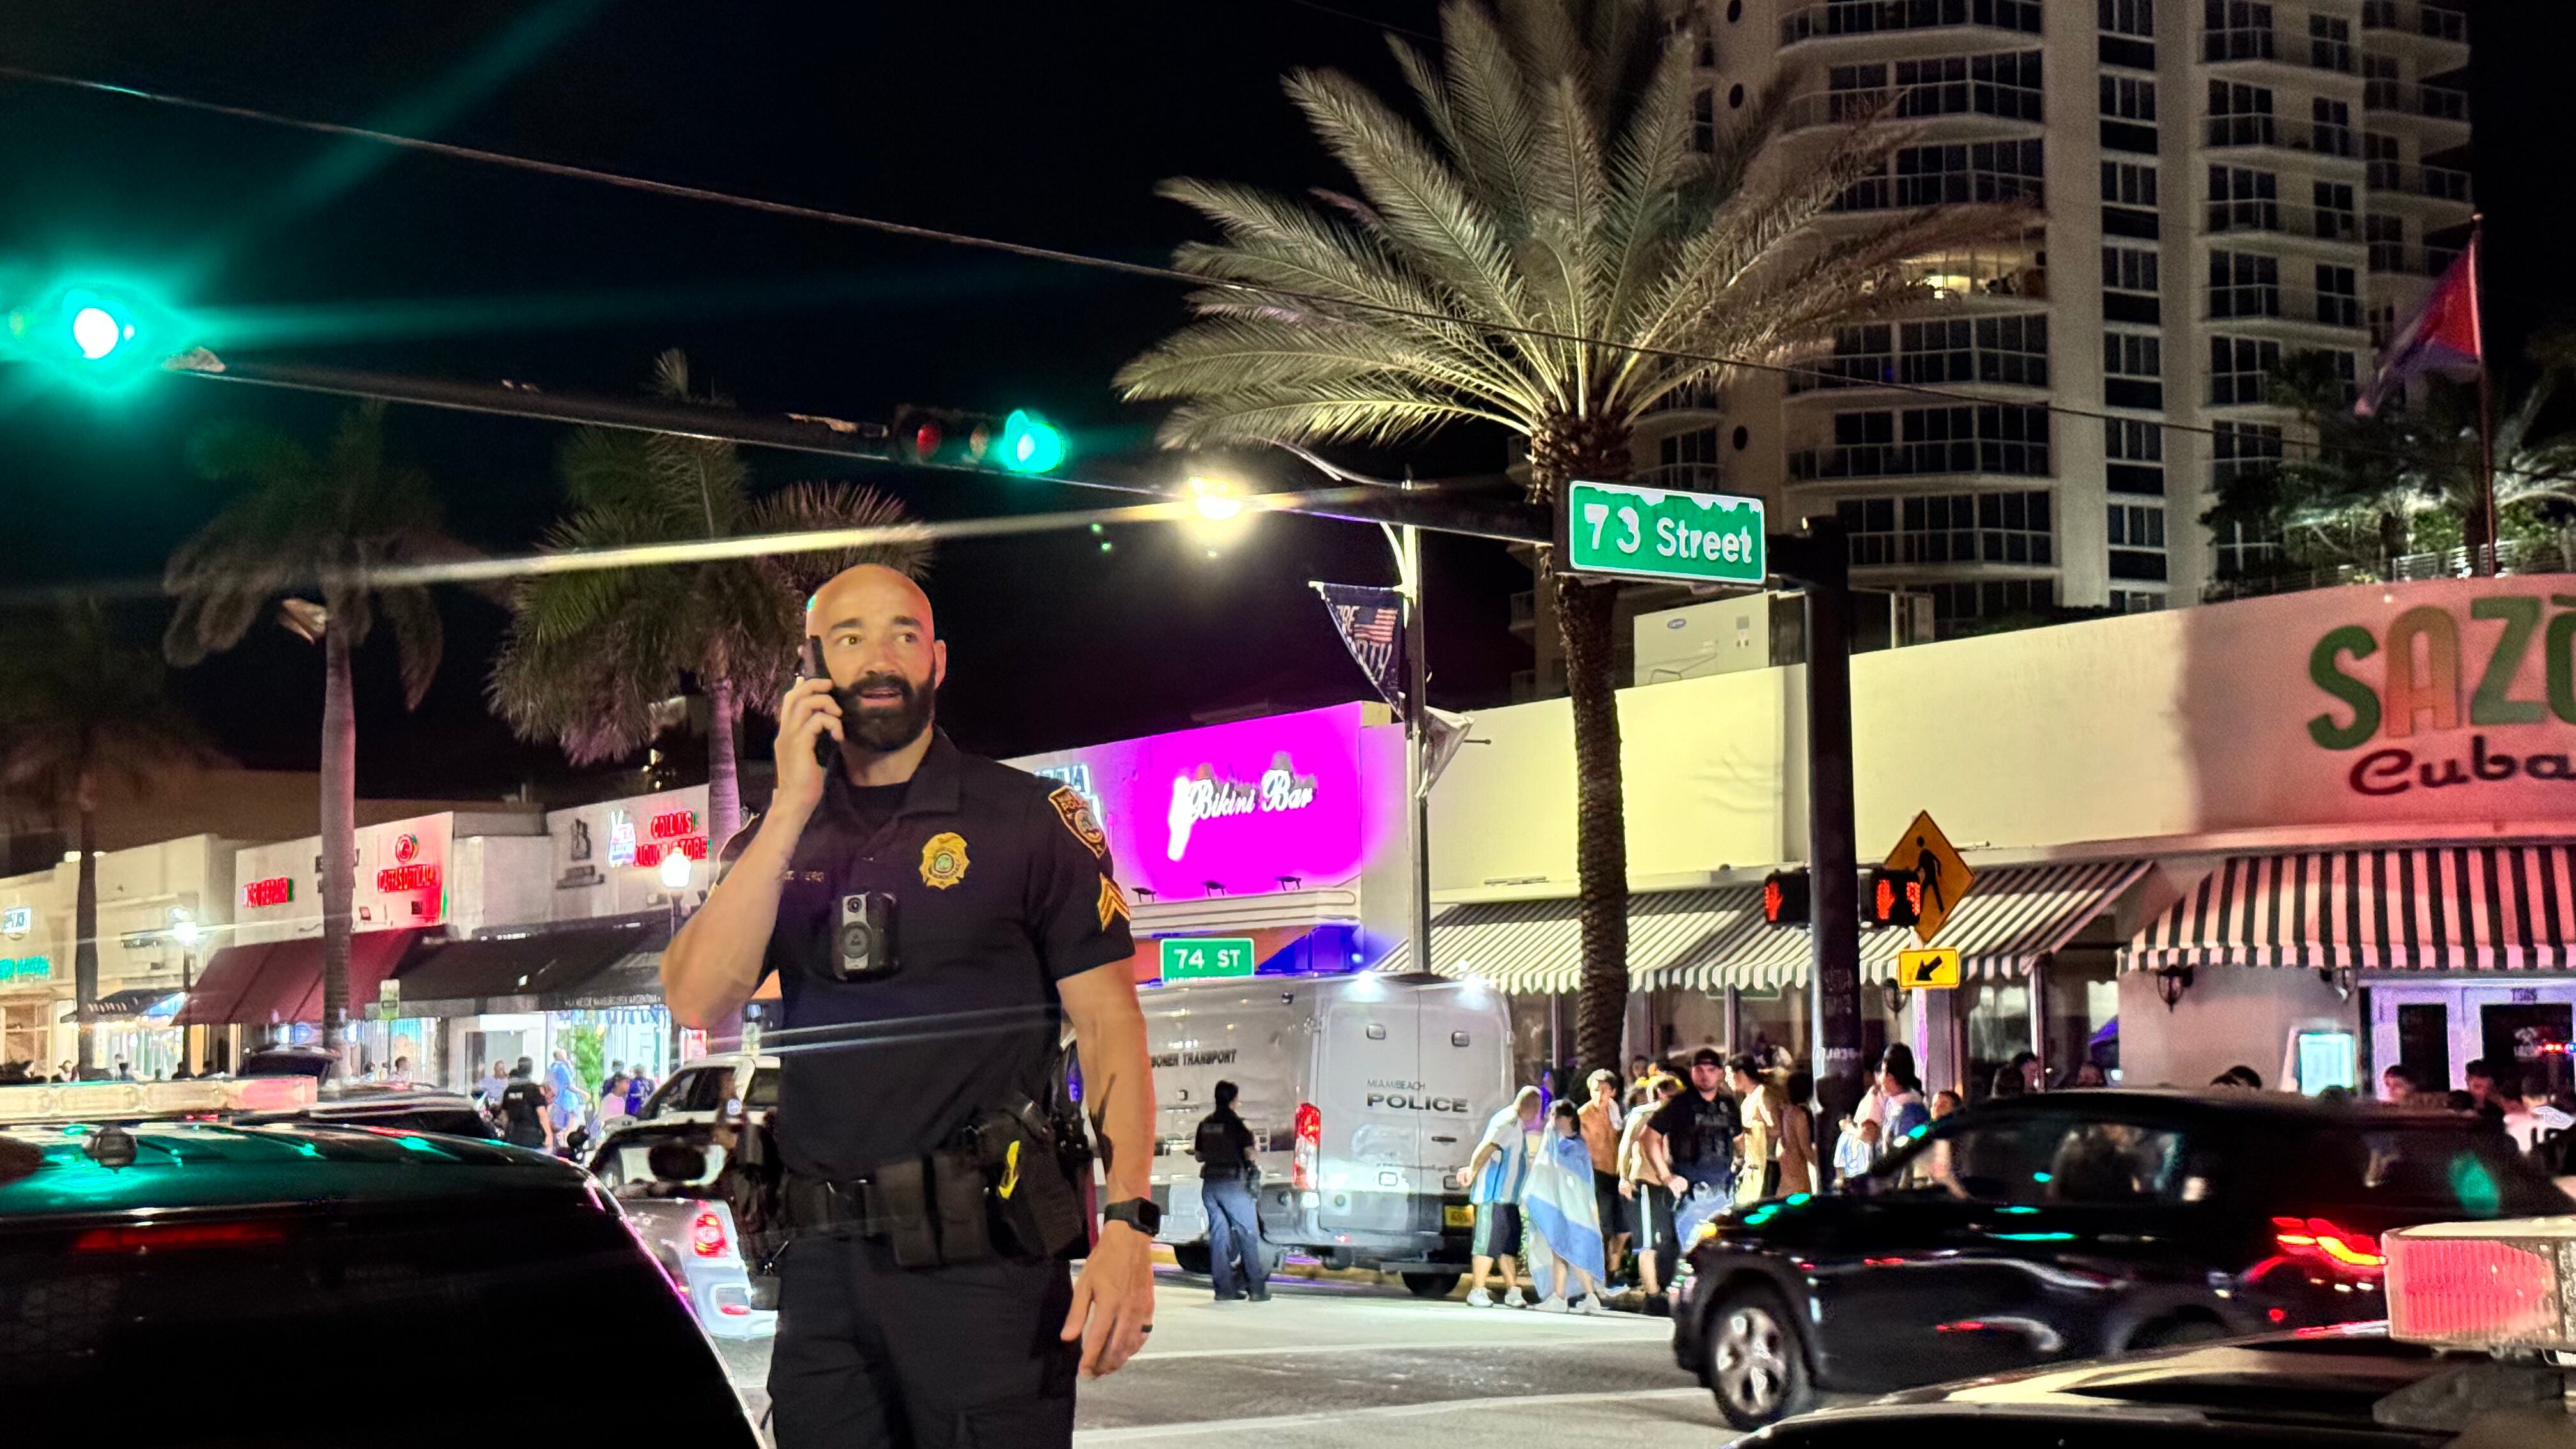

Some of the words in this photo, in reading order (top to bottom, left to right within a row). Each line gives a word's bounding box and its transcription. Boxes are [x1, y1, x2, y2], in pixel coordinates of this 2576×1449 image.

[1657, 517, 1752, 564] Street
[2349, 735, 2576, 796] Cuba
[1188, 779, 1255, 820] Bikini
[1261, 769, 1314, 811] Bar
[1173, 948, 1206, 970] 74
[1217, 949, 1241, 968] ST
[1183, 1048, 1237, 1066] TRANSPORT
[1367, 1092, 1469, 1113] POLICE
